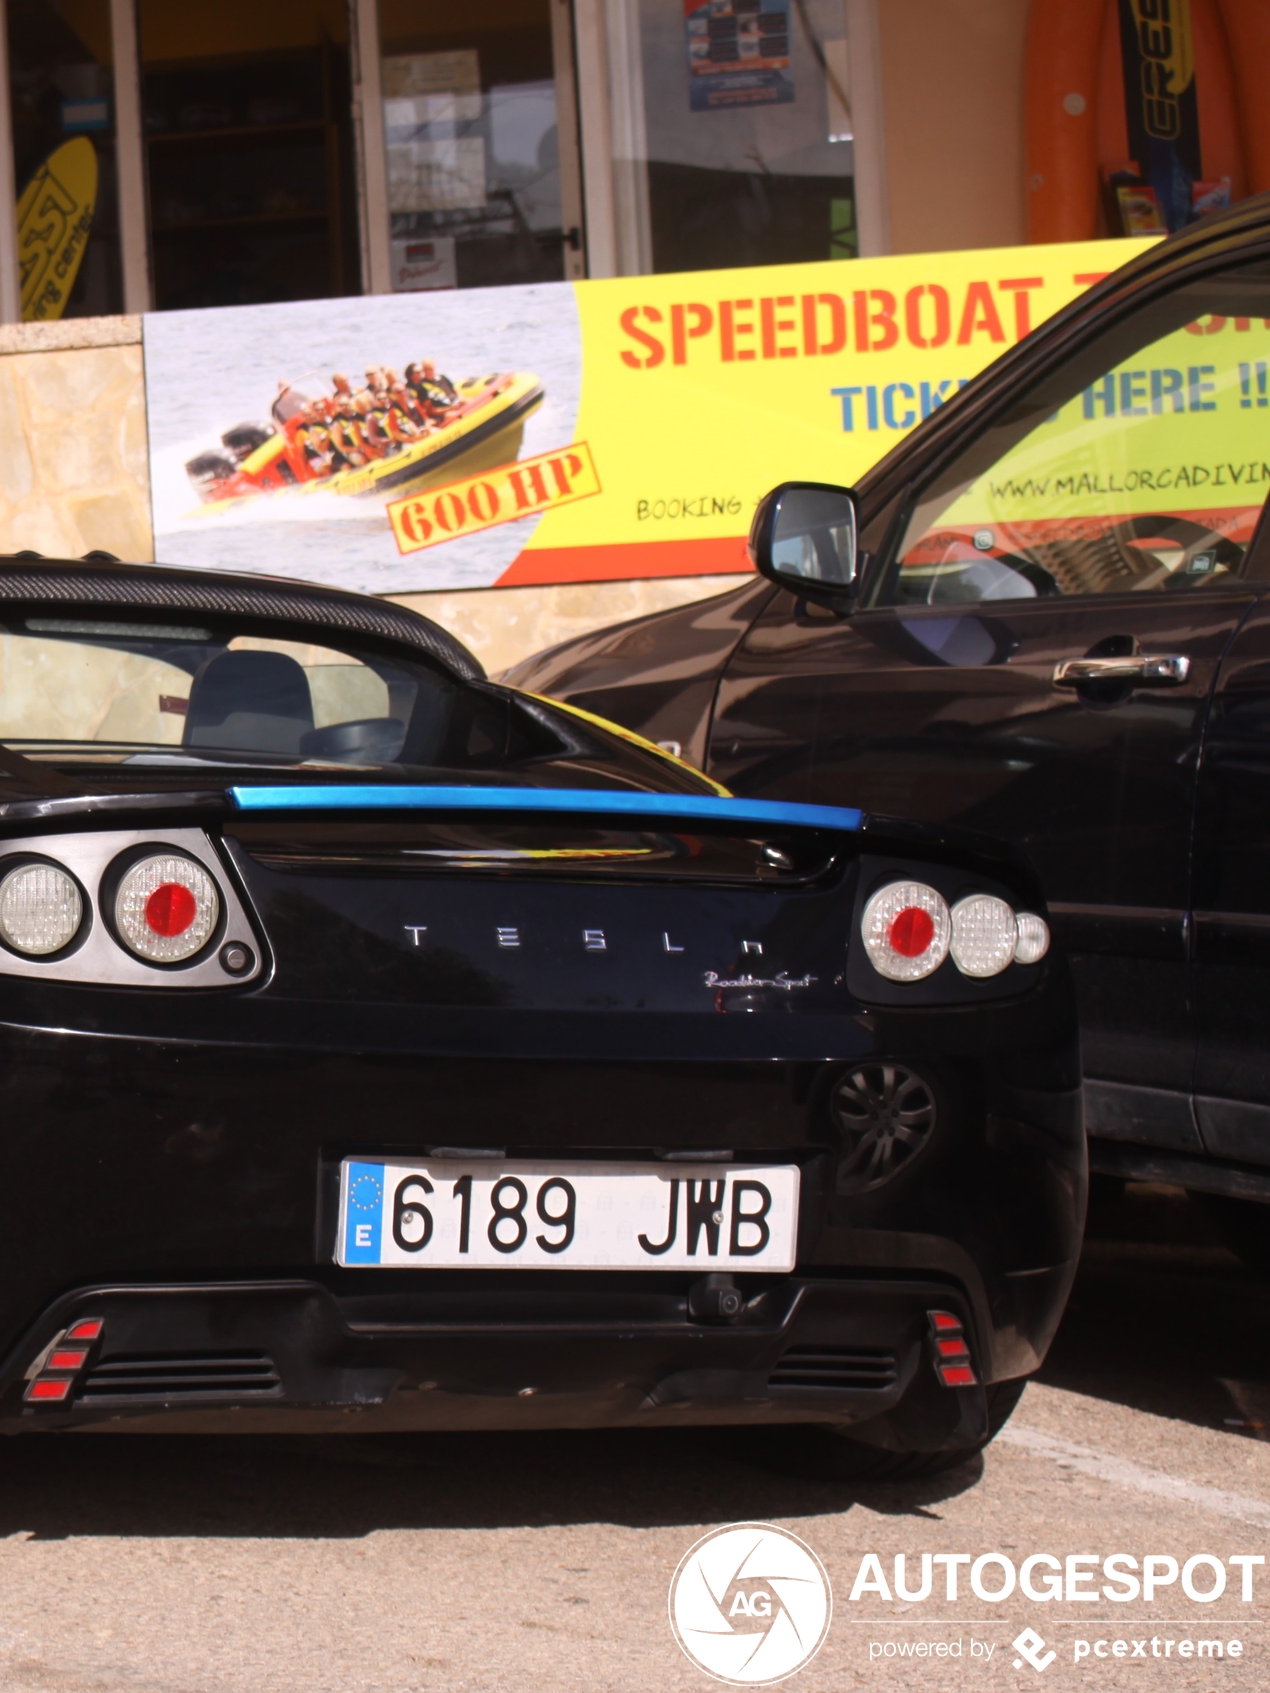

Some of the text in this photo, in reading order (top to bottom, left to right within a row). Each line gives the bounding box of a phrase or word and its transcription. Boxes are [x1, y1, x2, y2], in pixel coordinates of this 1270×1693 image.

[619, 276, 1045, 369] SPEEDBOAT
[1082, 364, 1217, 420] HERE
[400, 453, 583, 543] 600 HP
[637, 496, 742, 521] BOOKING
[404, 925, 763, 954] TESLA
[356, 1225, 372, 1246] E
[392, 1174, 773, 1257] 6189 JWB
